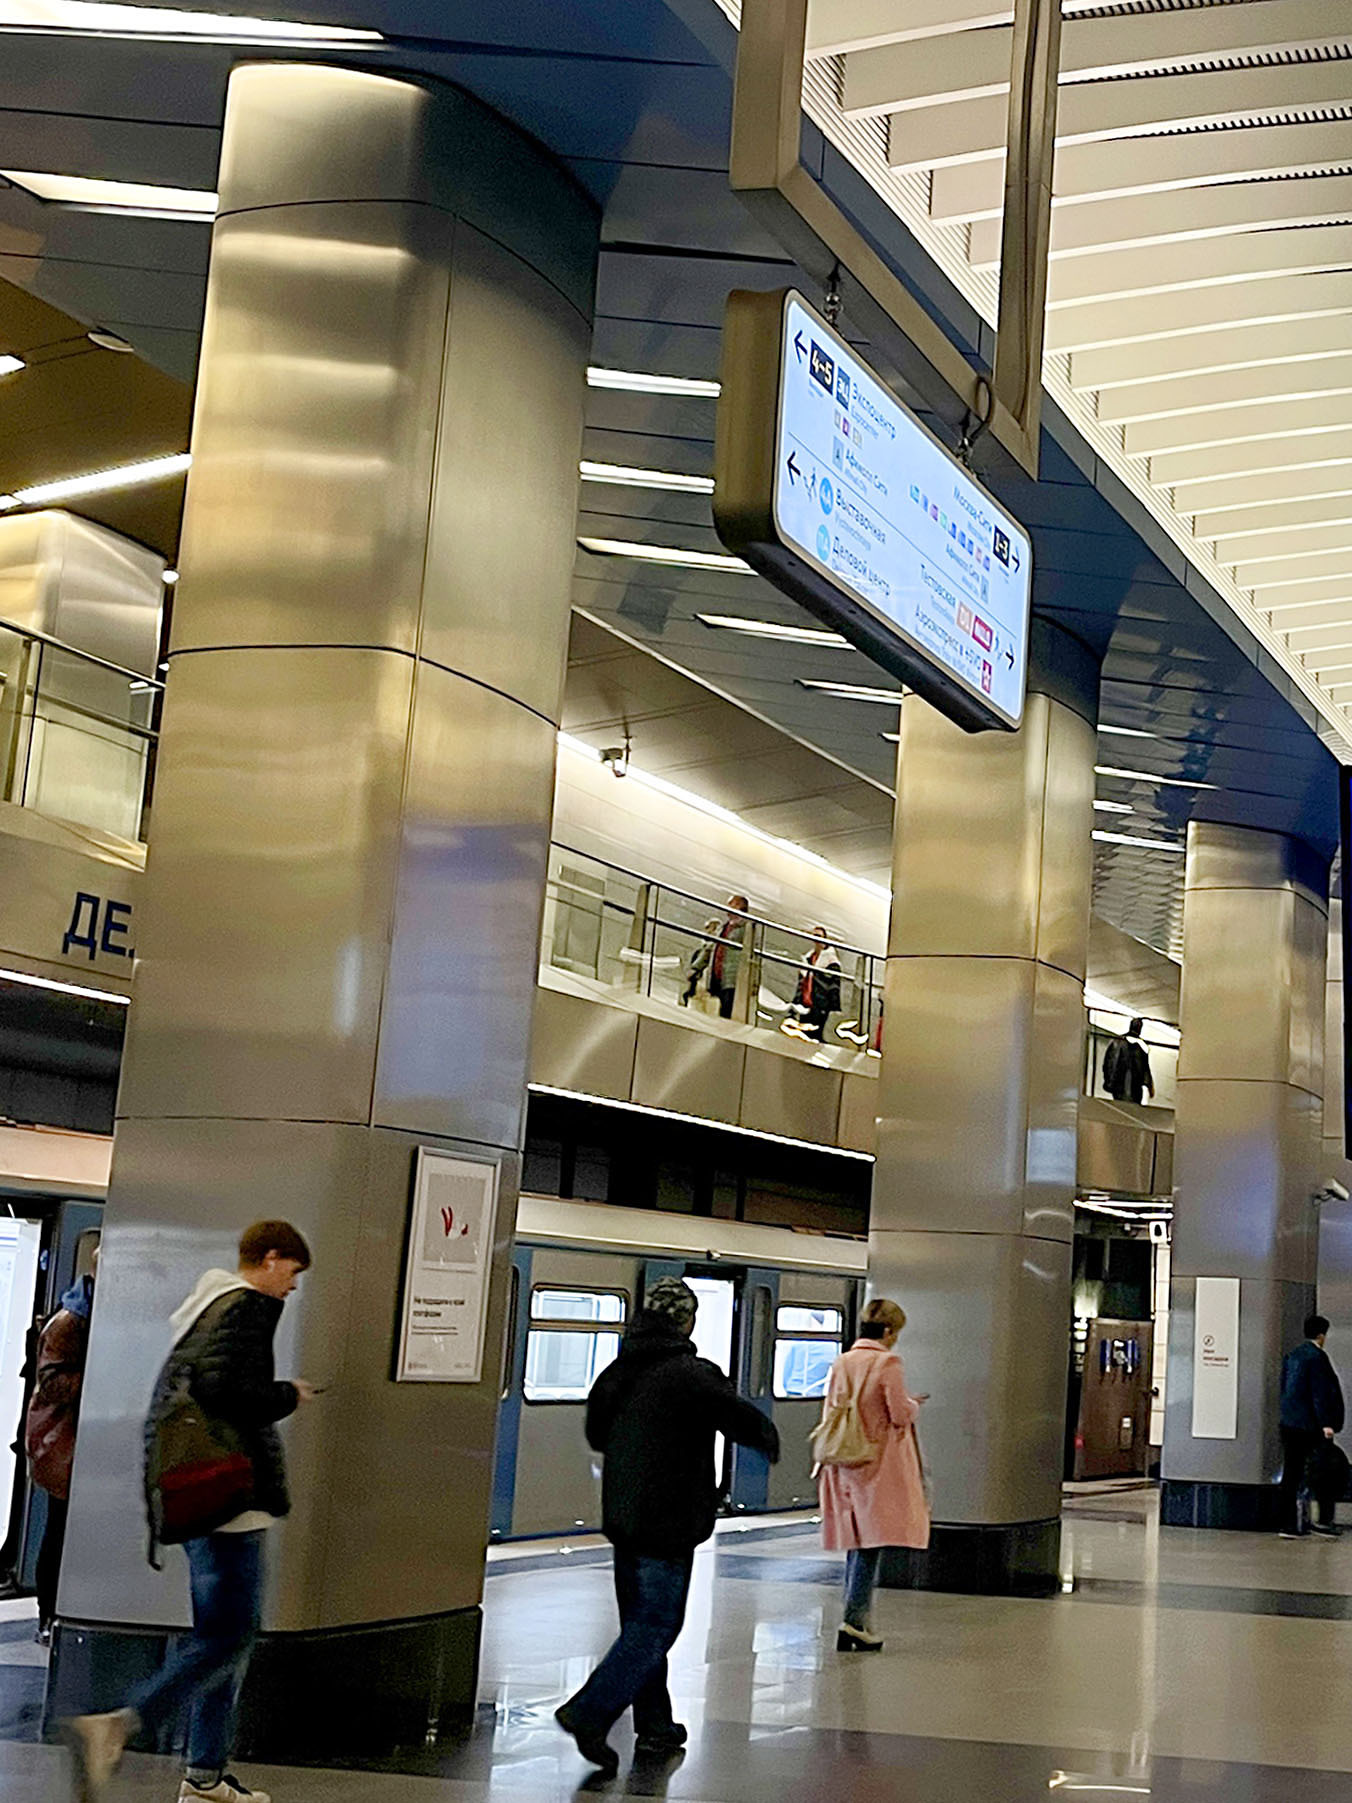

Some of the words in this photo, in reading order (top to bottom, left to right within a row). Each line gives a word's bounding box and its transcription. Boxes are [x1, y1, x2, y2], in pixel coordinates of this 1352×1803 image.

[835, 486, 887, 547] Выставочная
[832, 533, 868, 579] Деловой
[868, 567, 890, 600] центр
[61, 891, 136, 961] ДЕ
